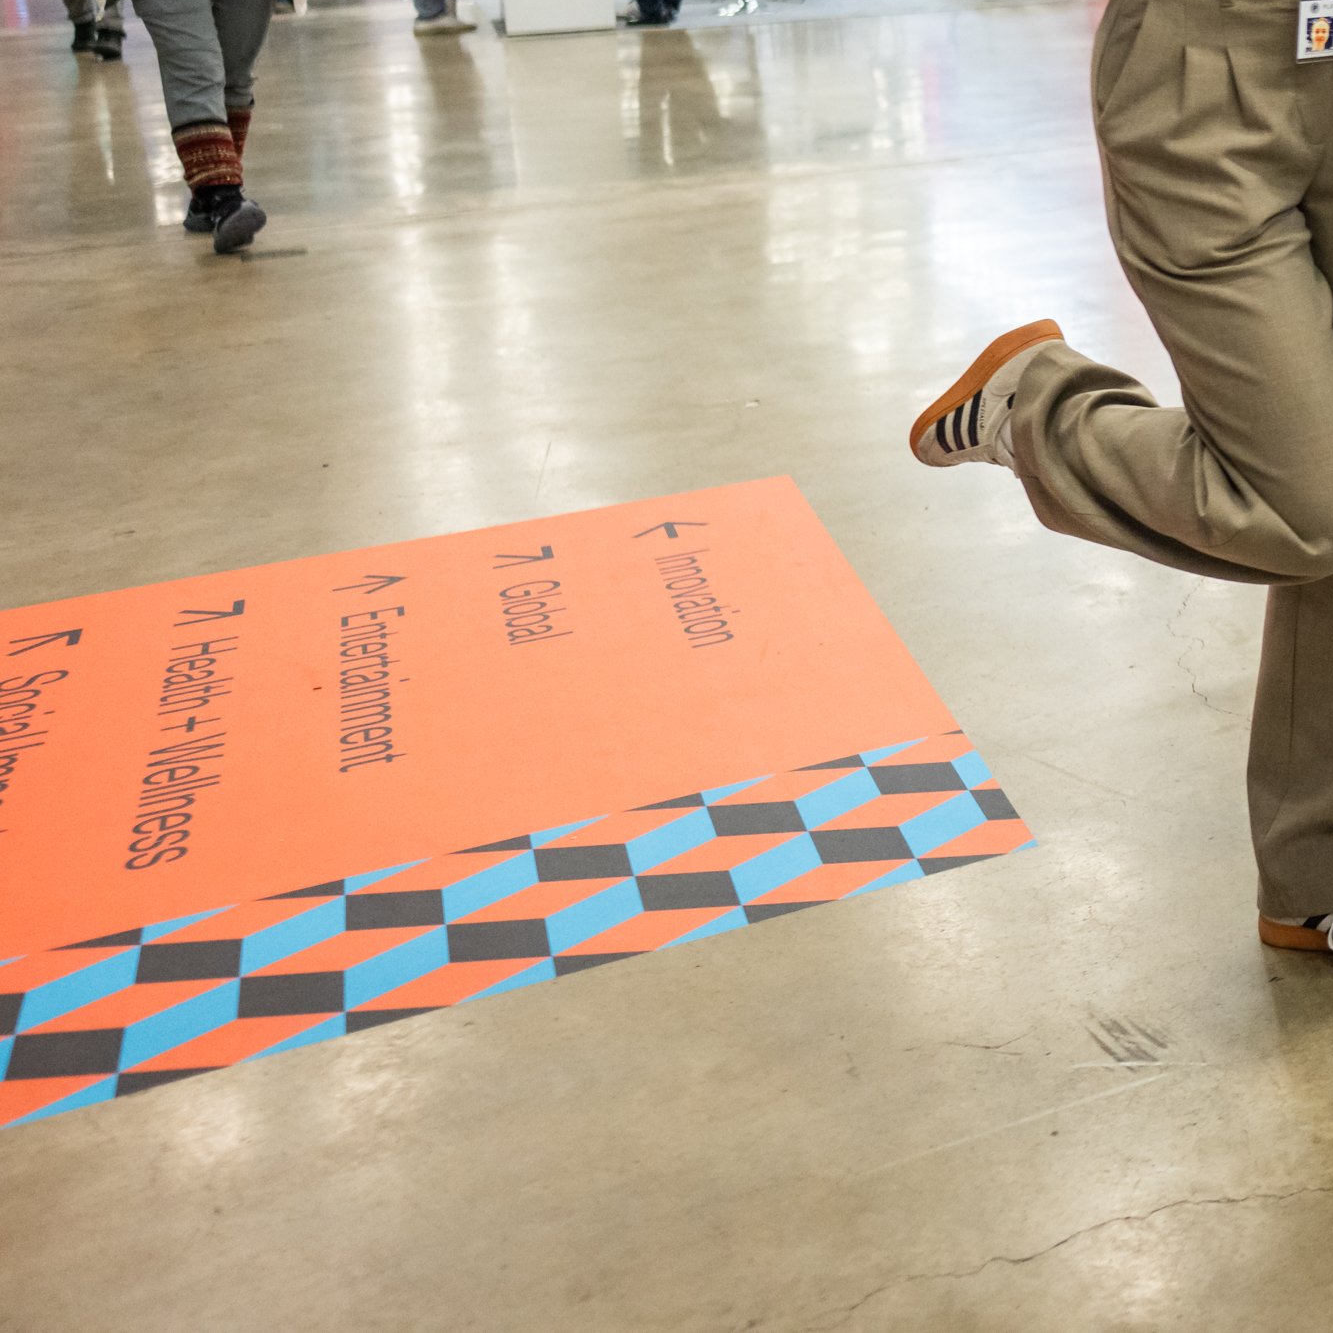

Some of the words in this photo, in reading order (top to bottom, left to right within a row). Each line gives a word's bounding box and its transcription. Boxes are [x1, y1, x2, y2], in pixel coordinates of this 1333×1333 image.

[498, 579, 574, 646] Global
[654, 548, 741, 649] Innovation
[157, 636, 239, 716] Health
[339, 606, 410, 773] Entertainment
[125, 731, 228, 871] Wellness
